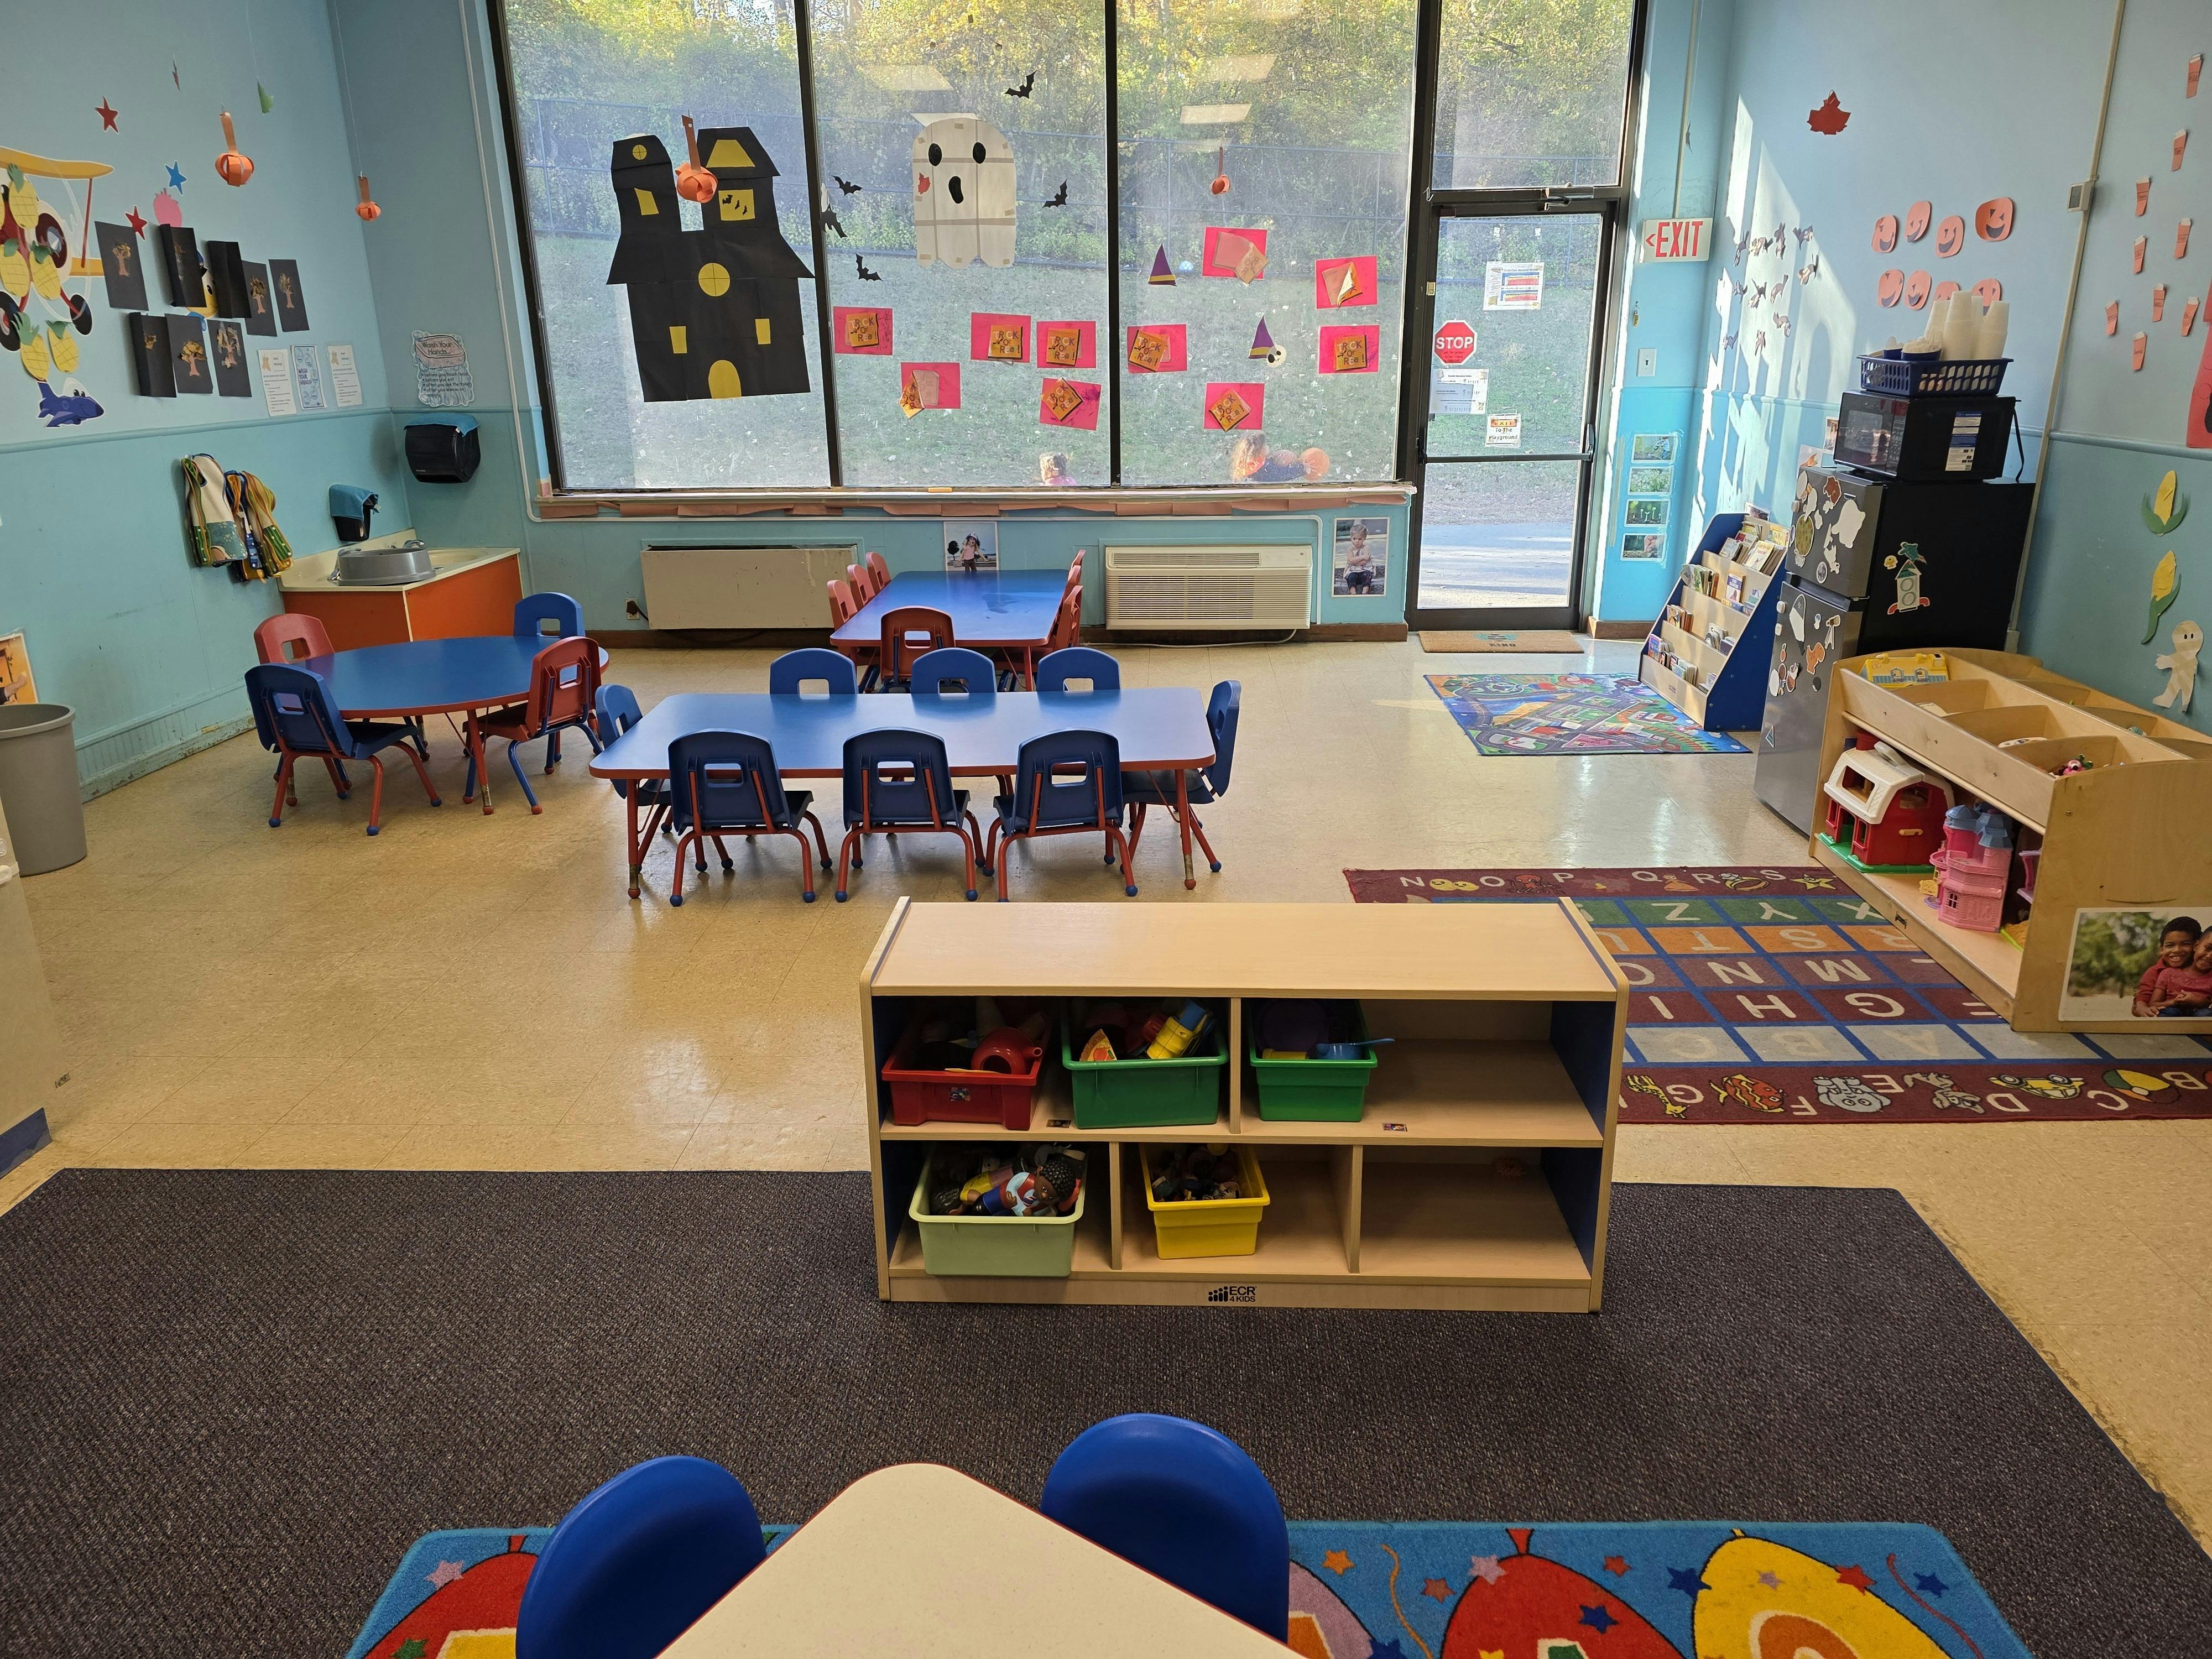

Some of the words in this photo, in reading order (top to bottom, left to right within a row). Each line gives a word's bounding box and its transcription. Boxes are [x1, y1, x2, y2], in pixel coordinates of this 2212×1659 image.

[1656, 221, 1703, 257] EXIT
[1436, 336, 1473, 349] STOP
[1399, 877, 1425, 887] N
[1479, 876, 1505, 887] O
[1552, 873, 1575, 883] P
[1632, 871, 1663, 882] Q
[1691, 873, 1721, 884] R
[1760, 869, 1787, 880] S
[1651, 902, 1700, 921] Z
[1759, 902, 1798, 920] Y
[1691, 931, 1731, 951] T
[1779, 928, 1827, 949] S
[1707, 962, 1765, 984] N
[1804, 959, 1872, 982] M
[1736, 995, 1796, 1019] H
[1845, 993, 1905, 1017] G
[1862, 1074, 1905, 1093] E
[2162, 1072, 2208, 1089] B
[1666, 1084, 1704, 1103] G
[1986, 1093, 2031, 1112] D
[2088, 1090, 2129, 1111] C
[1790, 1096, 1818, 1115] F
[1229, 1286, 1256, 1296] ECR
